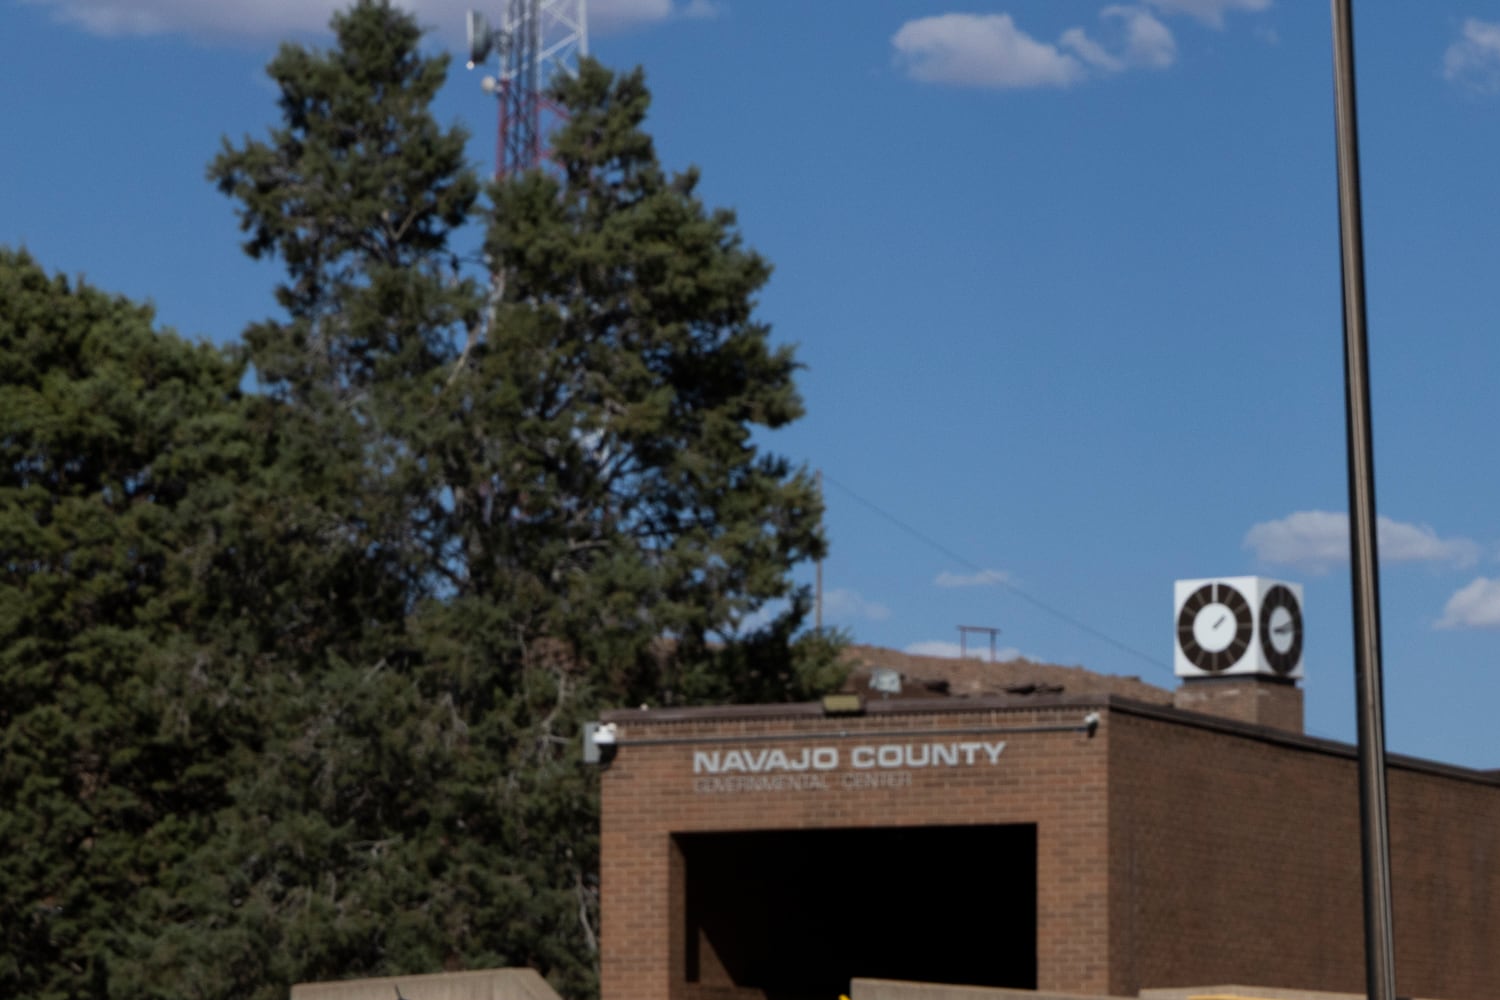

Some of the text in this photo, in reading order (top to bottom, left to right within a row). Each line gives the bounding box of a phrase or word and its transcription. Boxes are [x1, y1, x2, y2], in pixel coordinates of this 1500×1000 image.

[692, 741, 1006, 774] NAVAJO COUNTY
[841, 771, 912, 789] CENTER
